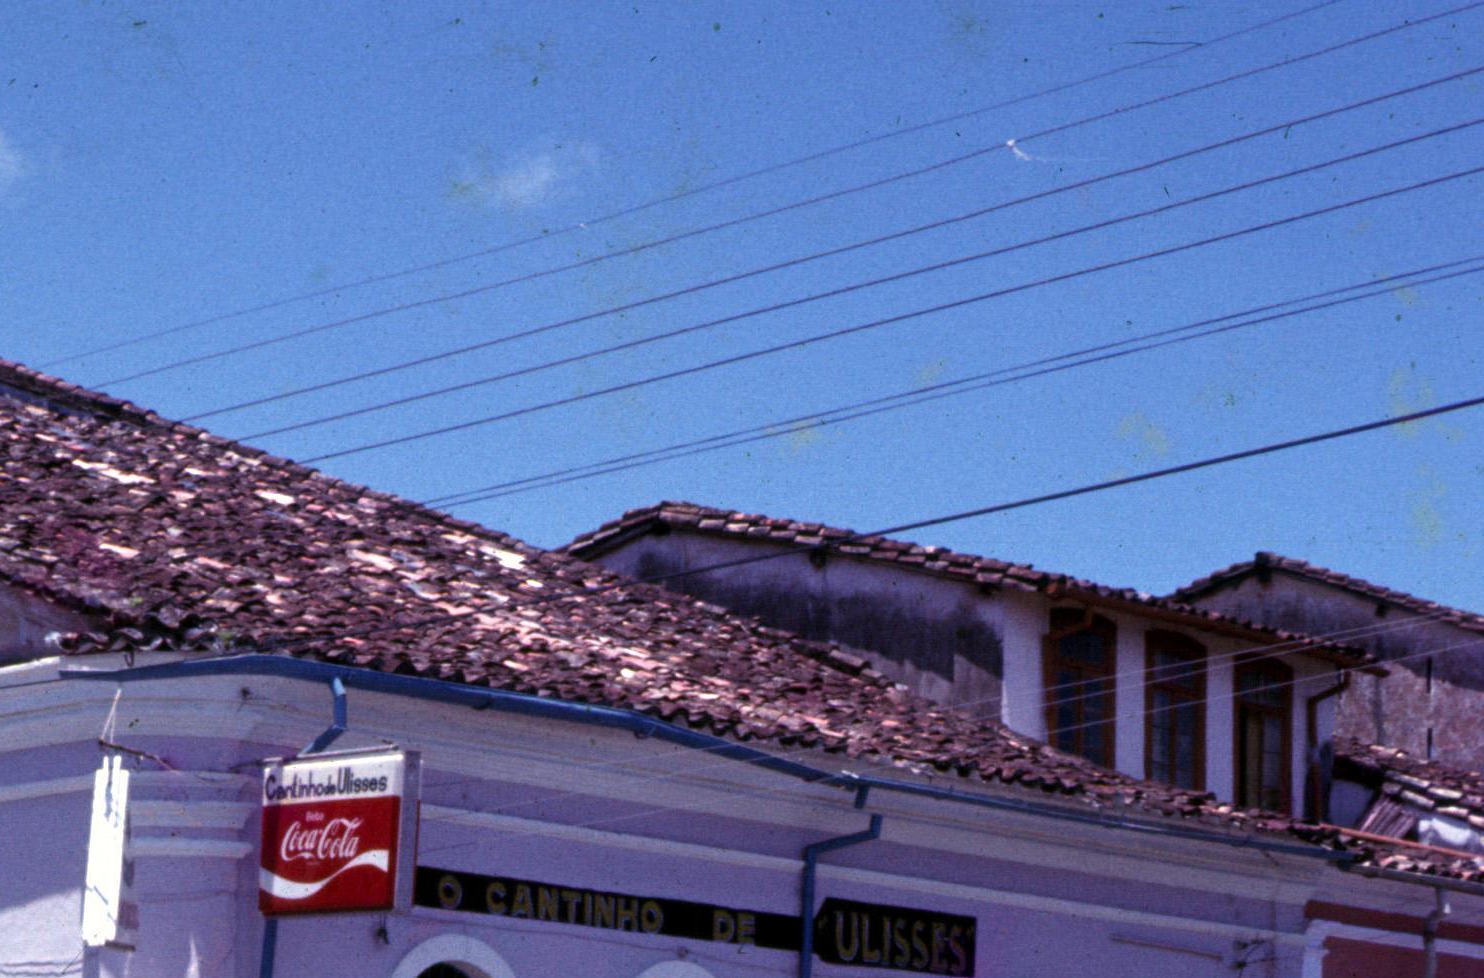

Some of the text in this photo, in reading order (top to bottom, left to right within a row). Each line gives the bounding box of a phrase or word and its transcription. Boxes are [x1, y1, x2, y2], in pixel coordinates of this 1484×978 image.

[265, 771, 325, 801] Cantinho
[337, 767, 388, 795] Ulisses
[281, 817, 365, 861] Coca-Cola
[437, 875, 463, 911] O
[485, 881, 664, 935] CANTINHO
[712, 909, 757, 945] DE
